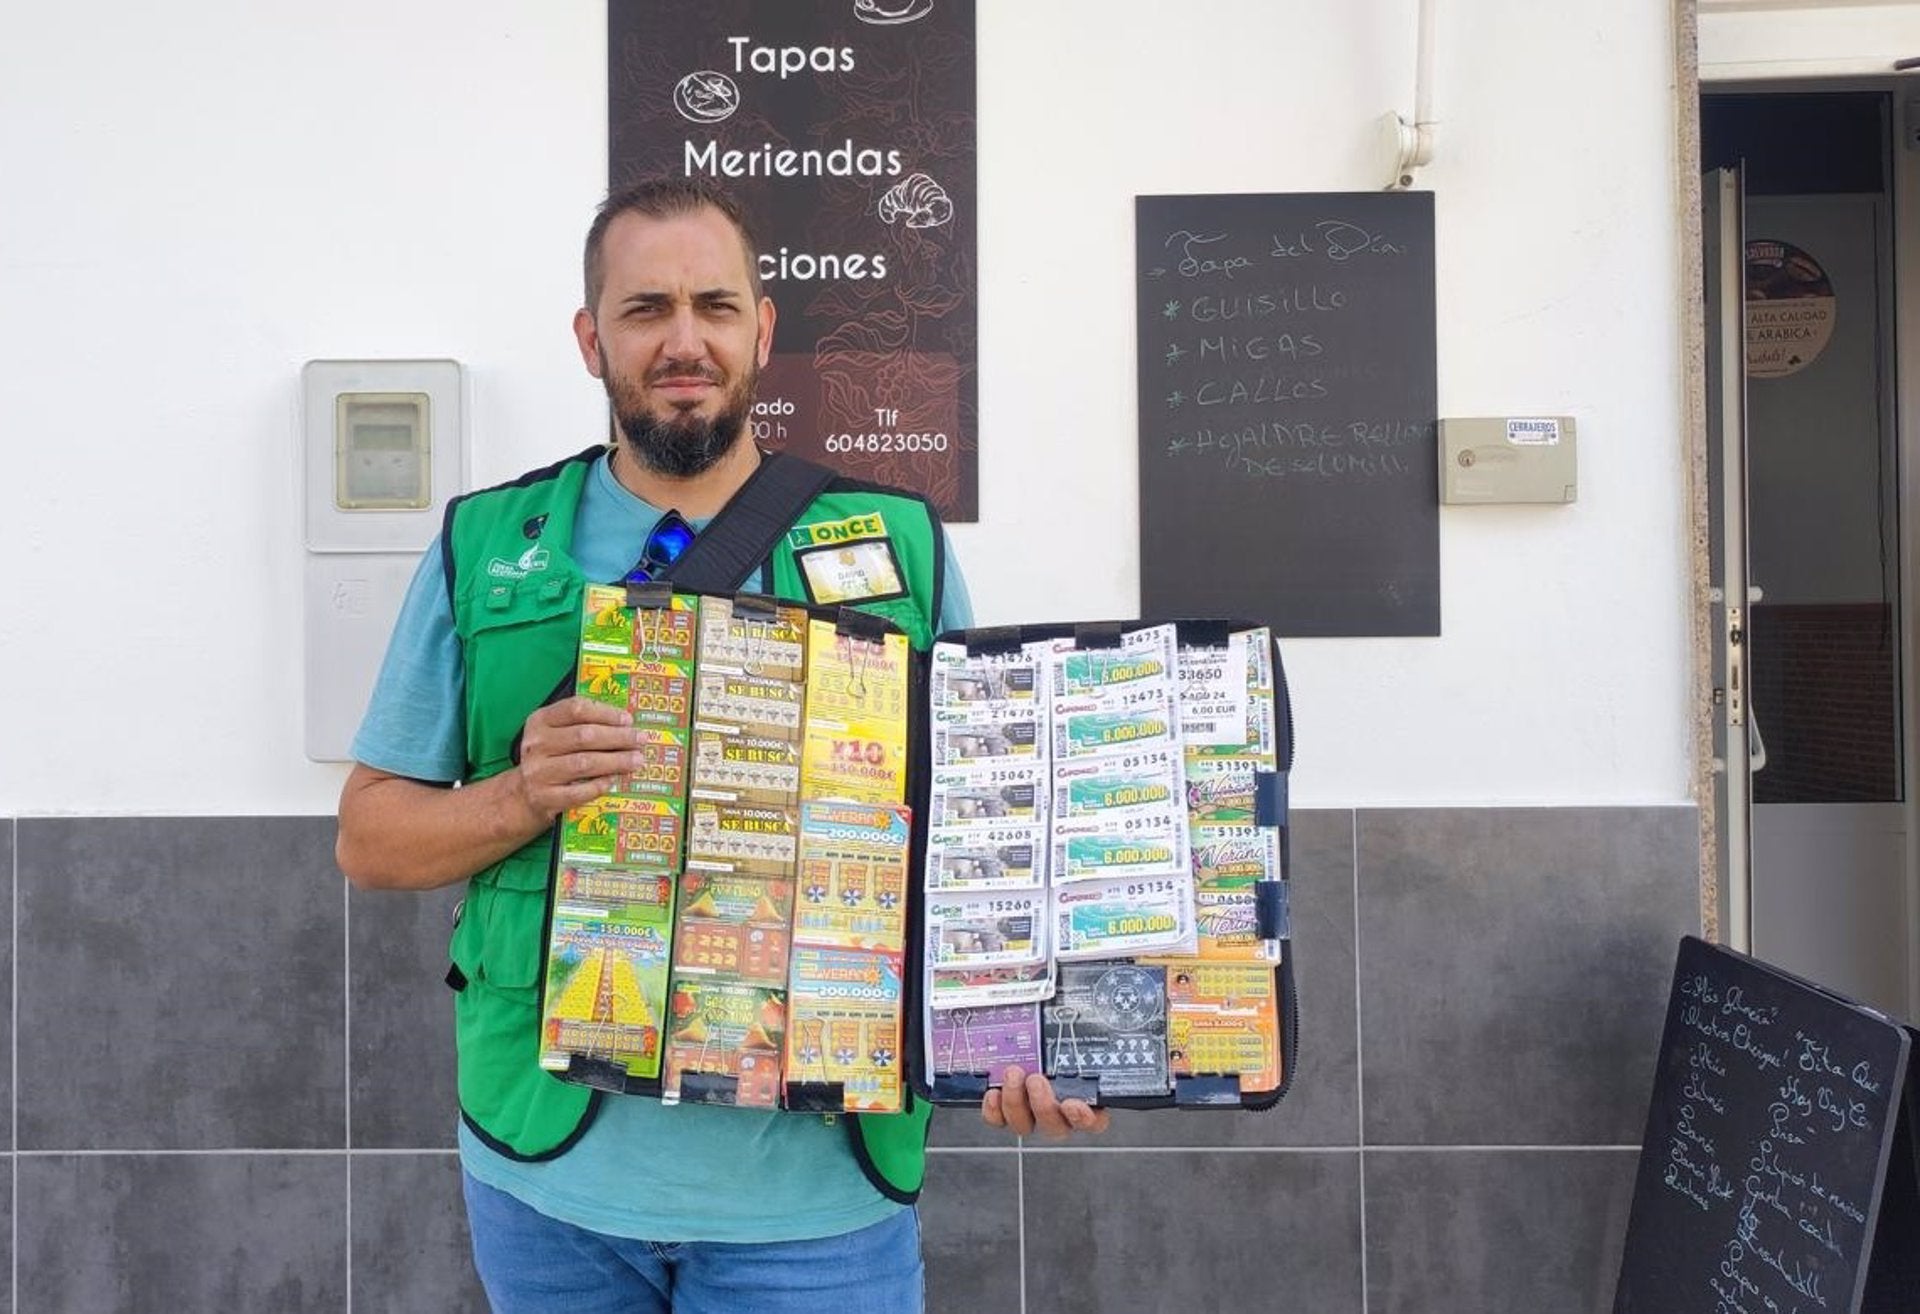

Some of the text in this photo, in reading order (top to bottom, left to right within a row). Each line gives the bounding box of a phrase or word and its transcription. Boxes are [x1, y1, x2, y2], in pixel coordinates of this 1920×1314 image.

[728, 36, 855, 78] Tapas
[684, 140, 902, 177] Meriendas
[757, 248, 887, 280] ciones
[752, 398, 795, 415] ado
[875, 408, 899, 427] Tlf
[825, 433, 948, 452] 604823050
[816, 518, 878, 540] ONCE
